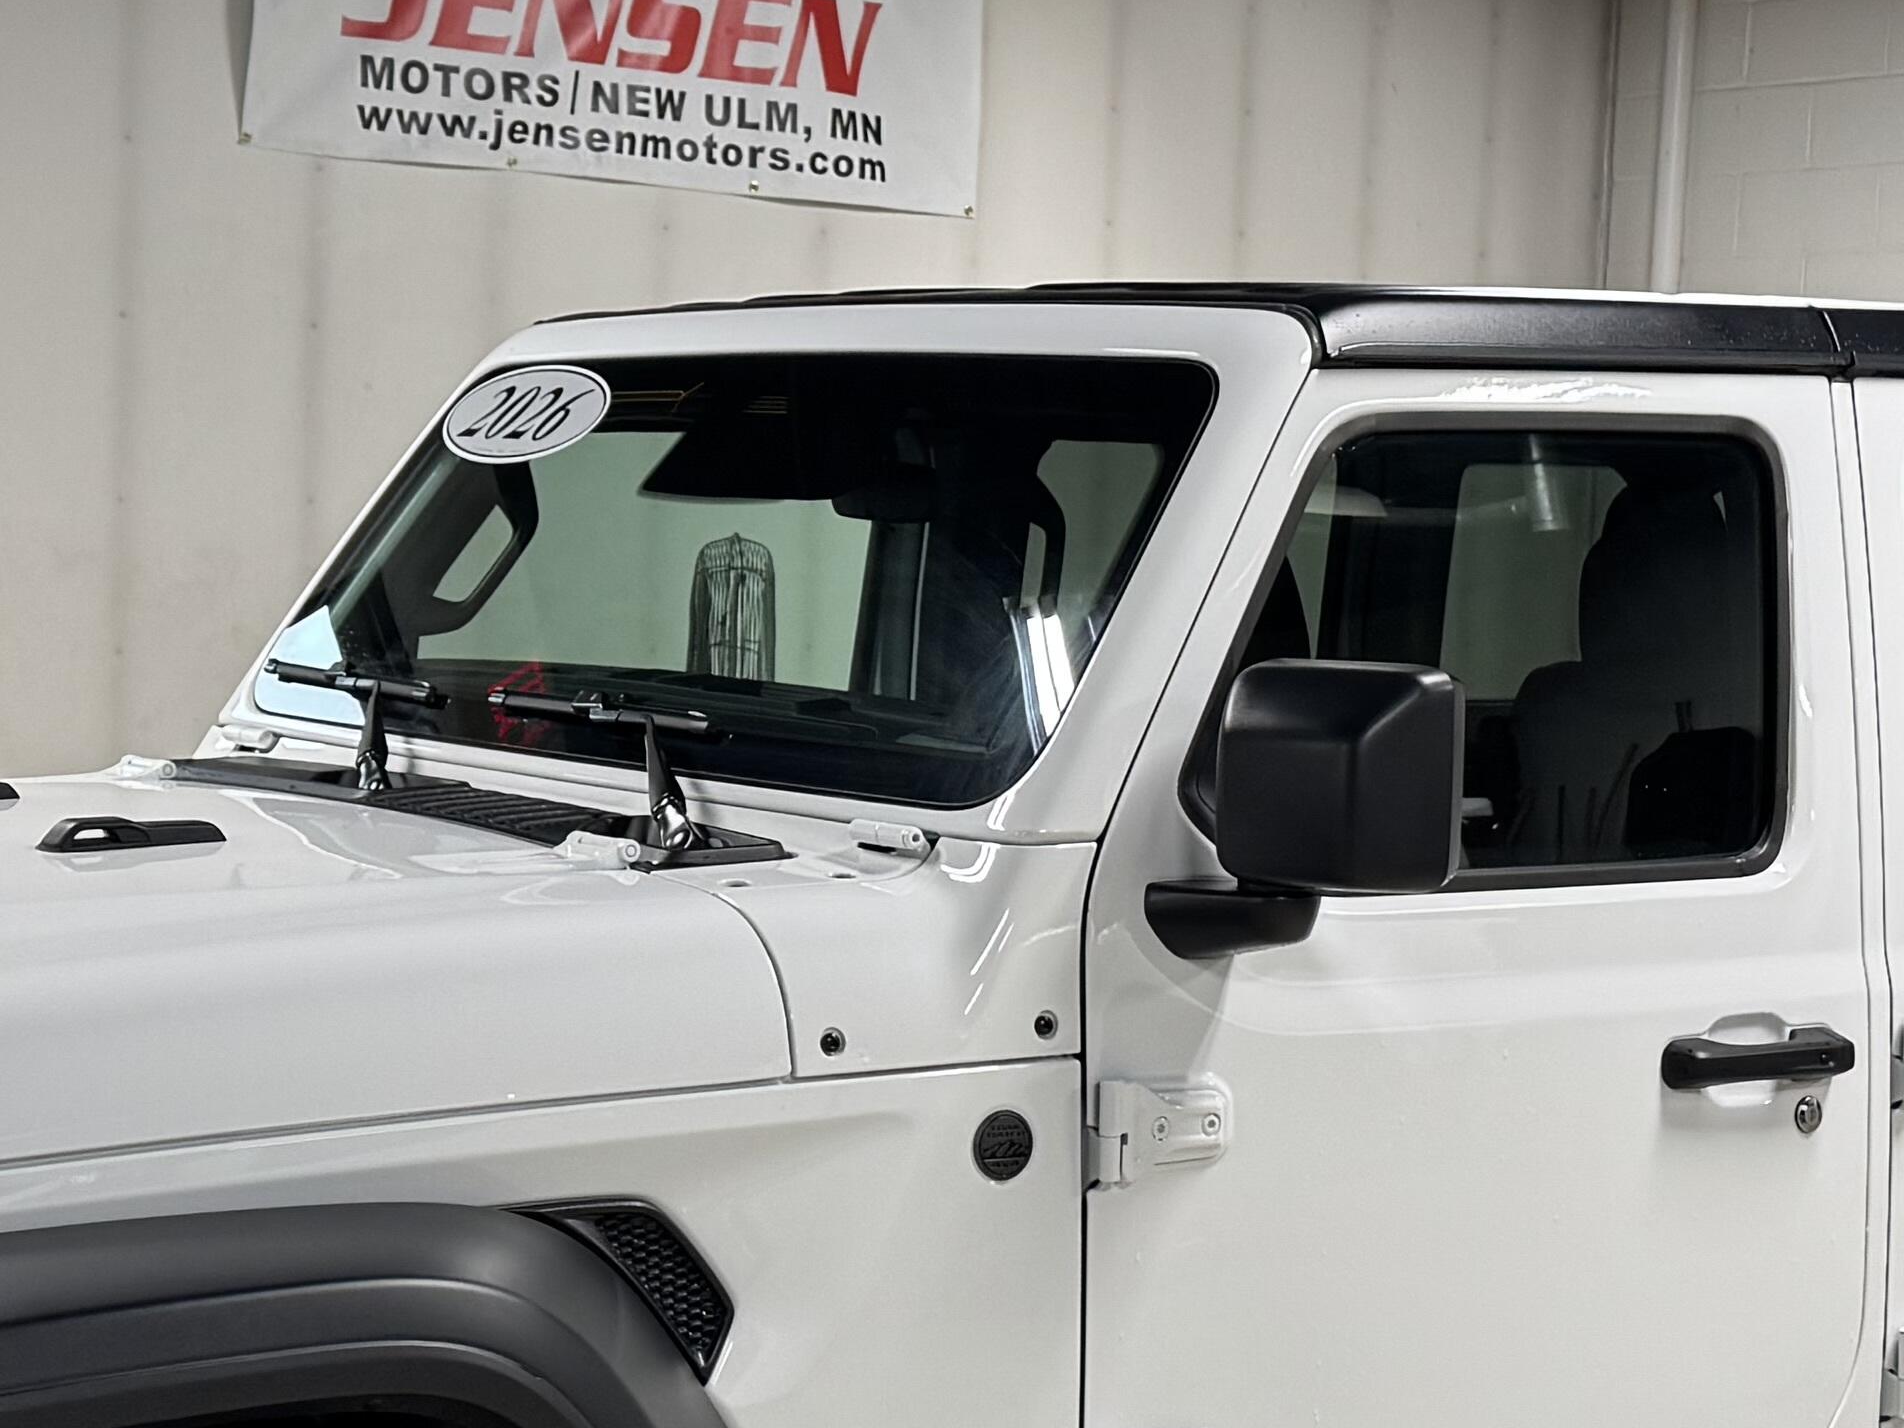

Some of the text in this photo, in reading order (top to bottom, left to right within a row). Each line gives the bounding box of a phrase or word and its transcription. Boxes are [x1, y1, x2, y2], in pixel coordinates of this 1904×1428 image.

[360, 54, 883, 146] MOTORS NEW ULM, MN
[357, 103, 887, 183] www.jensenmotors.com
[456, 385, 596, 442] 2026
